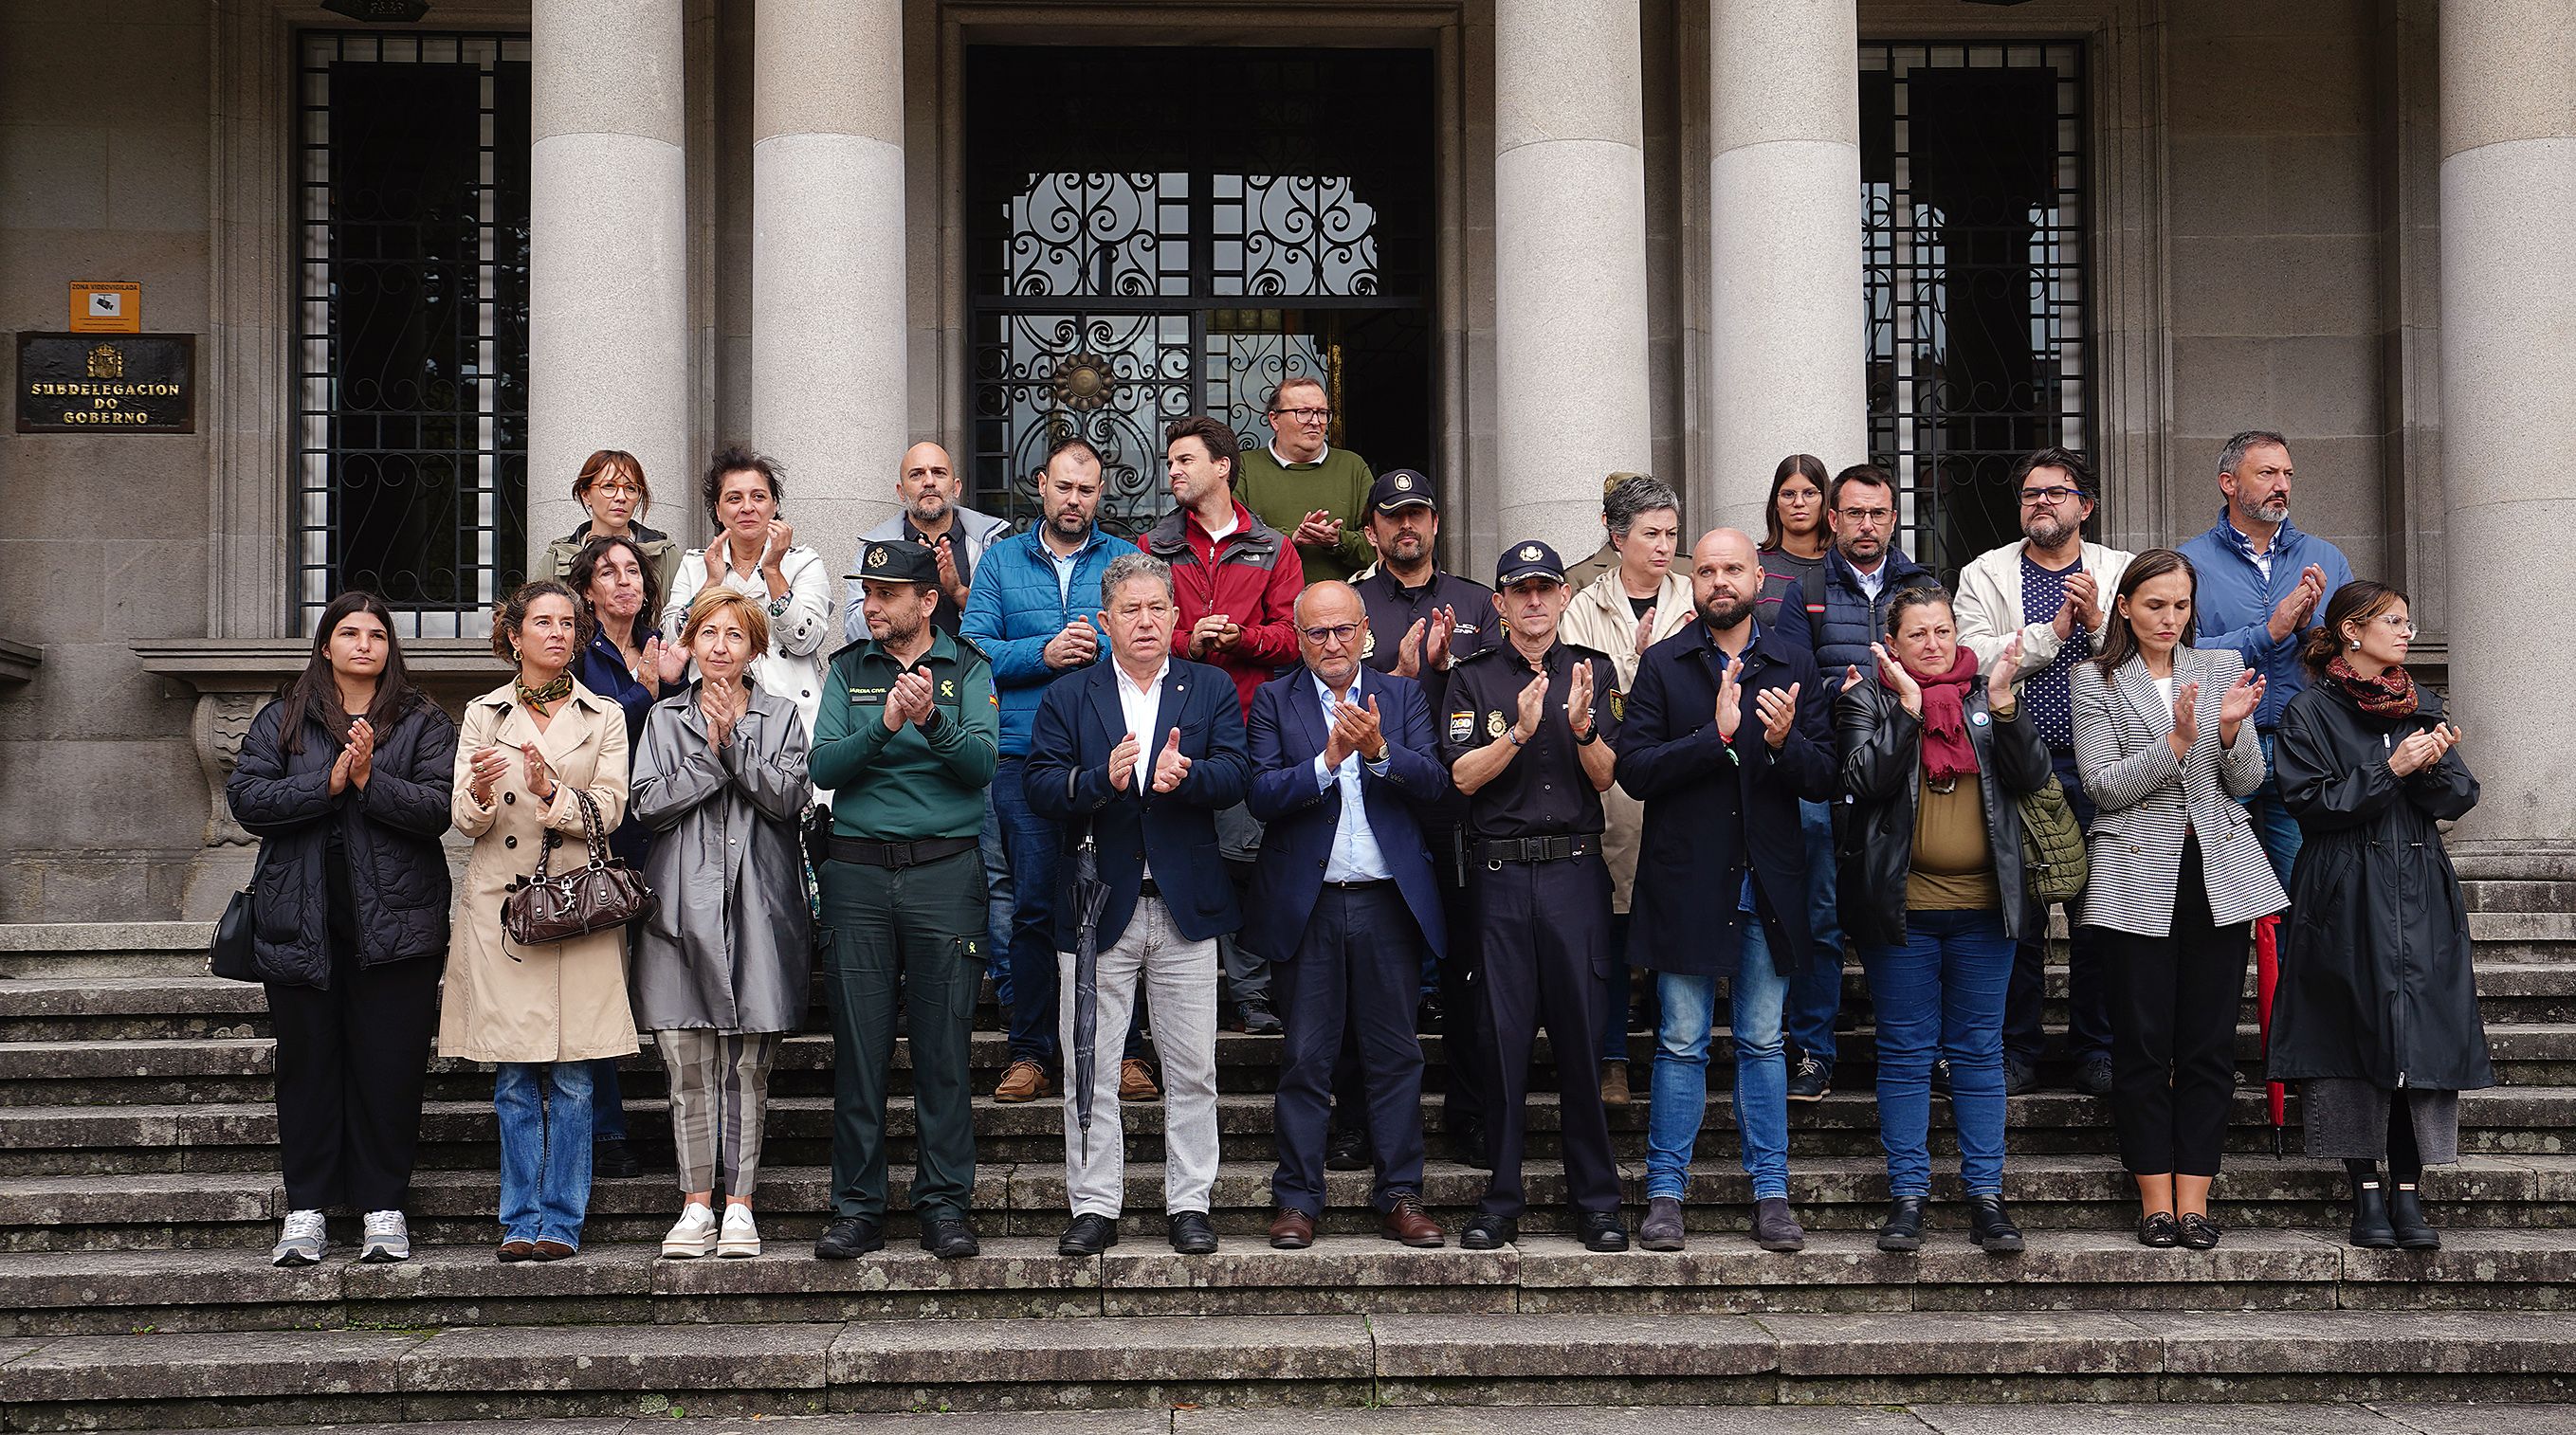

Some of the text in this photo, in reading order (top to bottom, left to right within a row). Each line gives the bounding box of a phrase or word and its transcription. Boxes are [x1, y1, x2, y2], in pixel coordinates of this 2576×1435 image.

[30, 383, 180, 396] SUBDELEGACION
[94, 398, 119, 409] DO
[63, 411, 149, 425] GOBERNO
